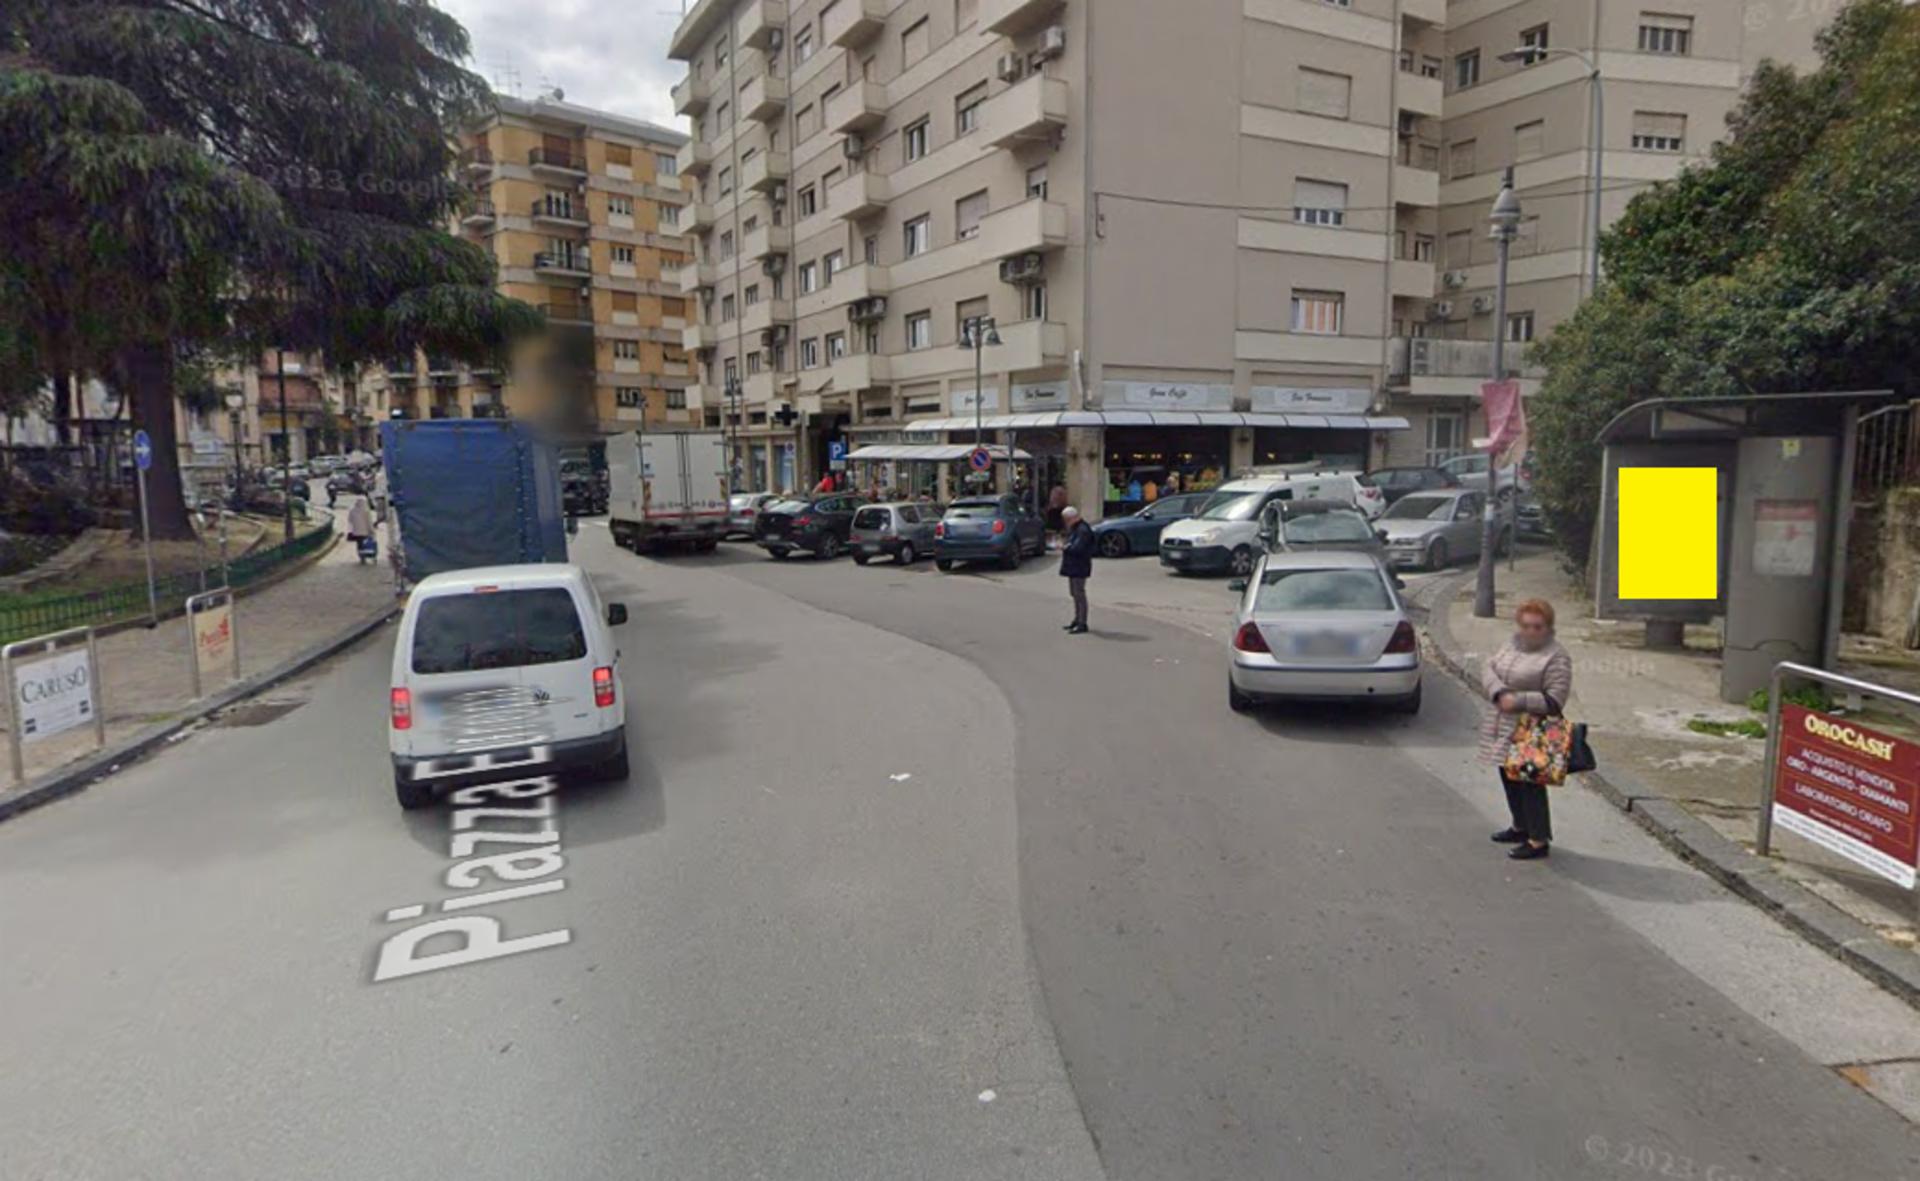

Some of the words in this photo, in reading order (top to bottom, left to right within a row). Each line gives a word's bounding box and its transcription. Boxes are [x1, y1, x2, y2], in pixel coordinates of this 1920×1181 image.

[832, 444, 842, 460] P
[21, 665, 86, 704] CARUSO
[1786, 755, 1806, 772] ORO
[1811, 766, 1854, 791] ARGENTO
[1860, 784, 1908, 814] DIAMANTI
[1802, 748, 1845, 773] ACQUISTO
[1855, 769, 1895, 792] VENDITA
[1795, 780, 1858, 817] LABORATORIO
[1858, 808, 1893, 833] ORAFO
